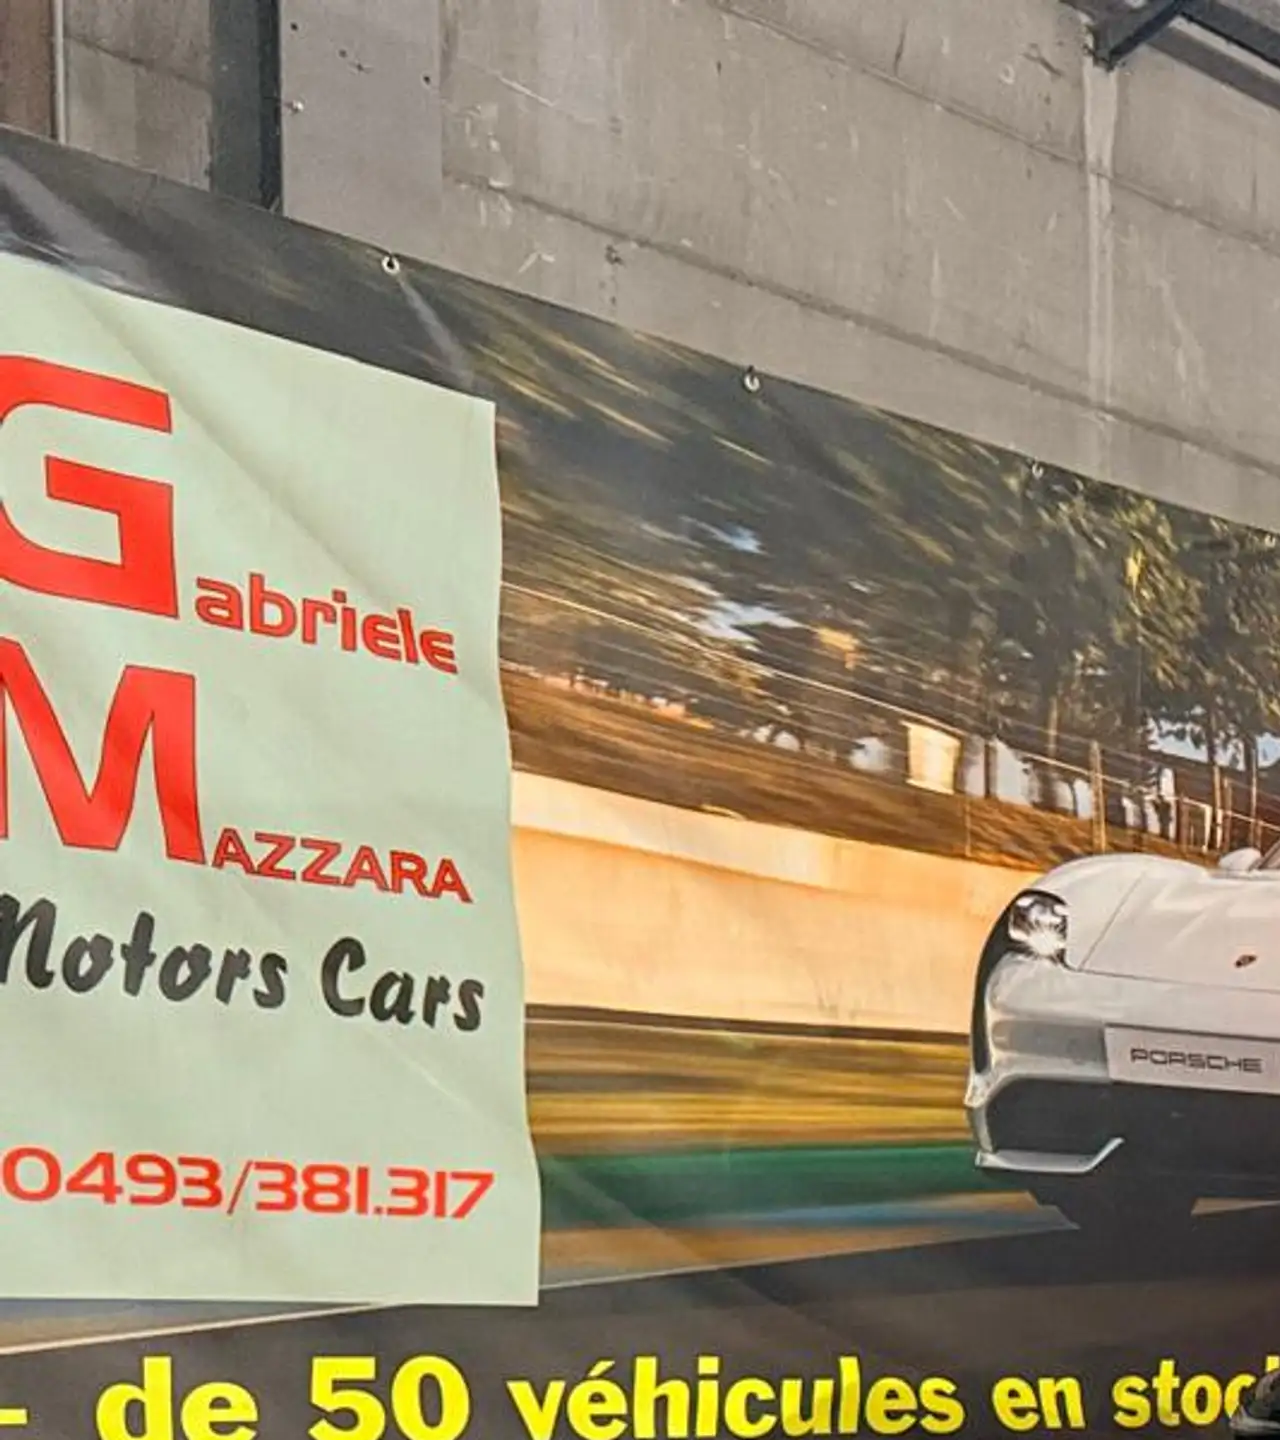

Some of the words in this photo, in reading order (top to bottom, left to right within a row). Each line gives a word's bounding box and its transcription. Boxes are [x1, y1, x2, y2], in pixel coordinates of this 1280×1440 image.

[0, 894, 288, 1008] Motors
[322, 936, 485, 1032] Cars
[1130, 1048, 1263, 1074] PORSCHE
[2, 1147, 495, 1219] 0493/381.317
[992, 1375, 1085, 1432] en
[1112, 1355, 1280, 1428] stoc
